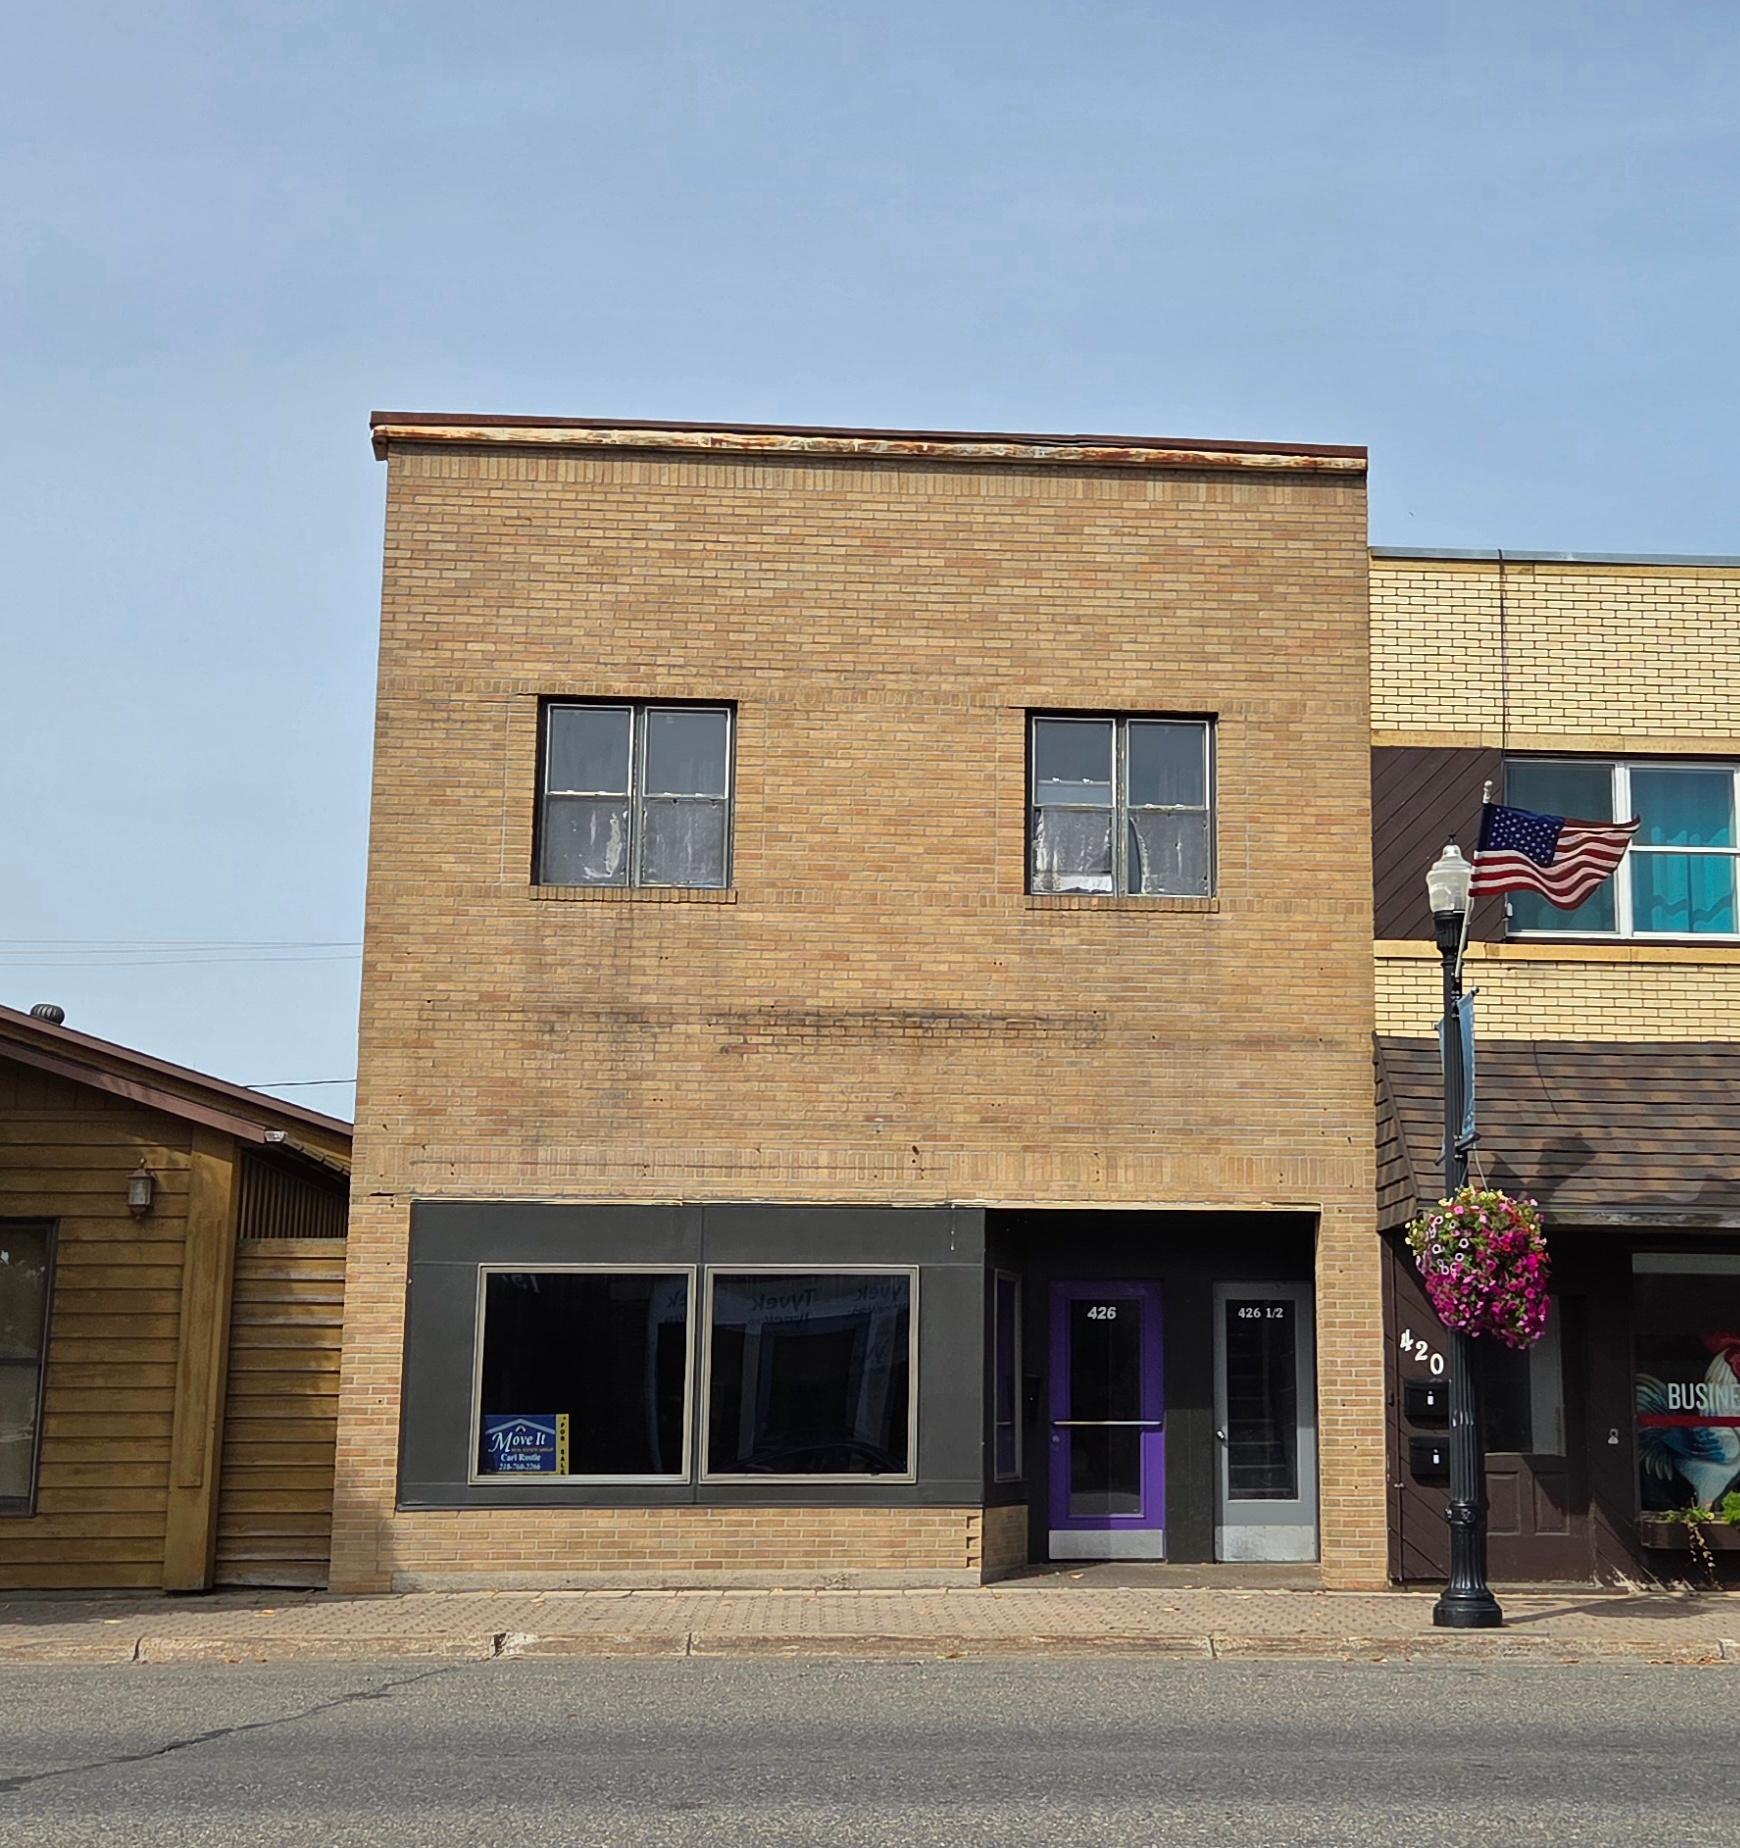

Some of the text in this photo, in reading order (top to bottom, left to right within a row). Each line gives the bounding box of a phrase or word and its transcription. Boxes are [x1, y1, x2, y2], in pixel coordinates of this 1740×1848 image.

[1087, 1307, 1117, 1320] 426
[1237, 1307, 1284, 1319] 426 1/2
[1399, 1328, 1445, 1376] 420
[488, 1431, 546, 1453] Move It
